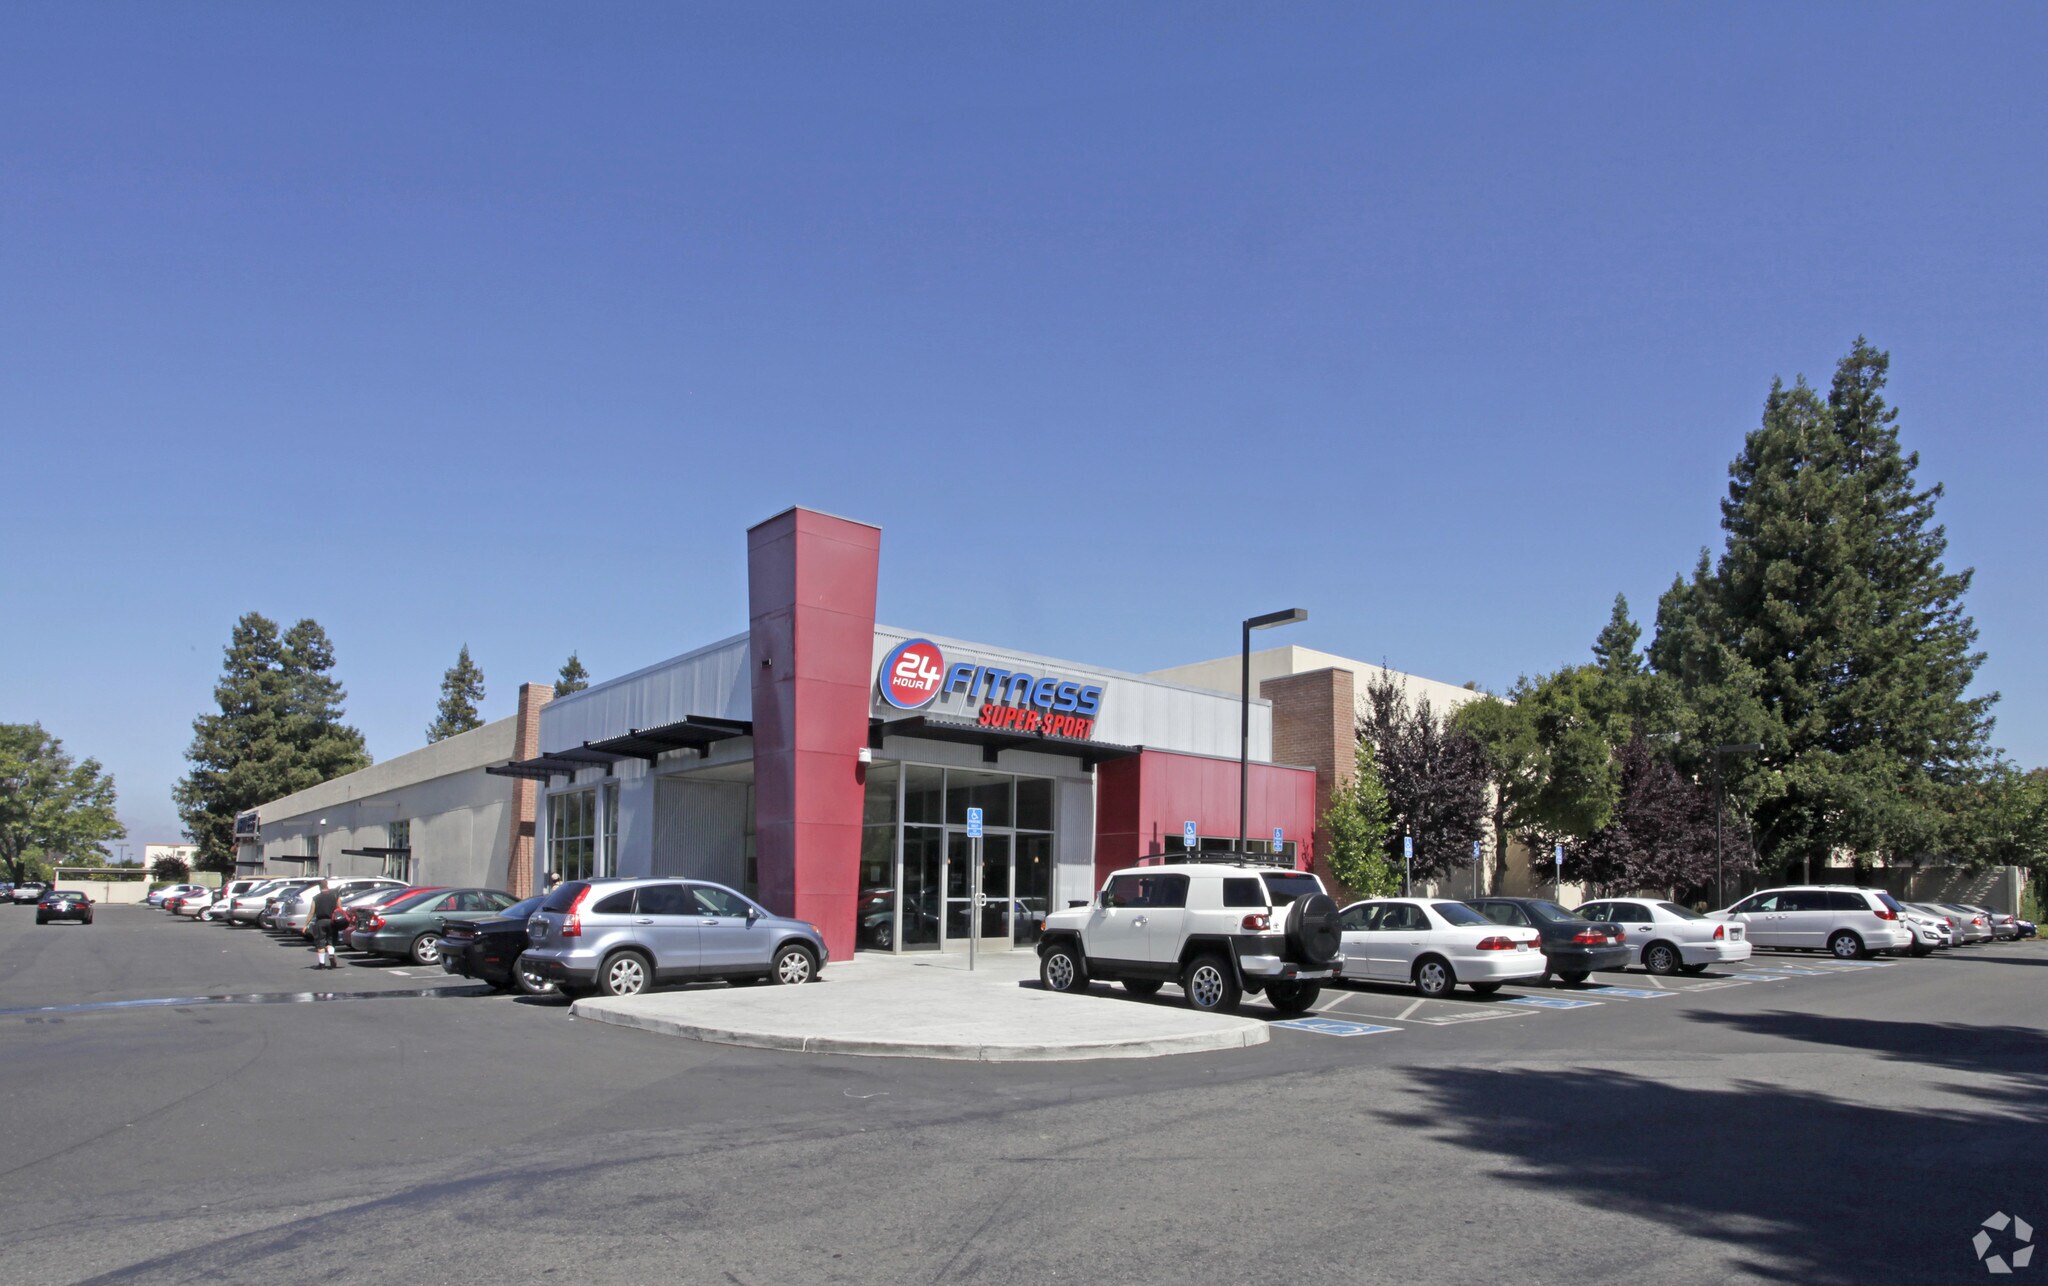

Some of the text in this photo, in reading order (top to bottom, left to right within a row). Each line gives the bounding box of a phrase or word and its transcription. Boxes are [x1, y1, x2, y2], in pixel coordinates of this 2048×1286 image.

[893, 676, 924, 690] HOUR
[896, 652, 941, 691] 24
[944, 662, 1103, 716] FITNESS
